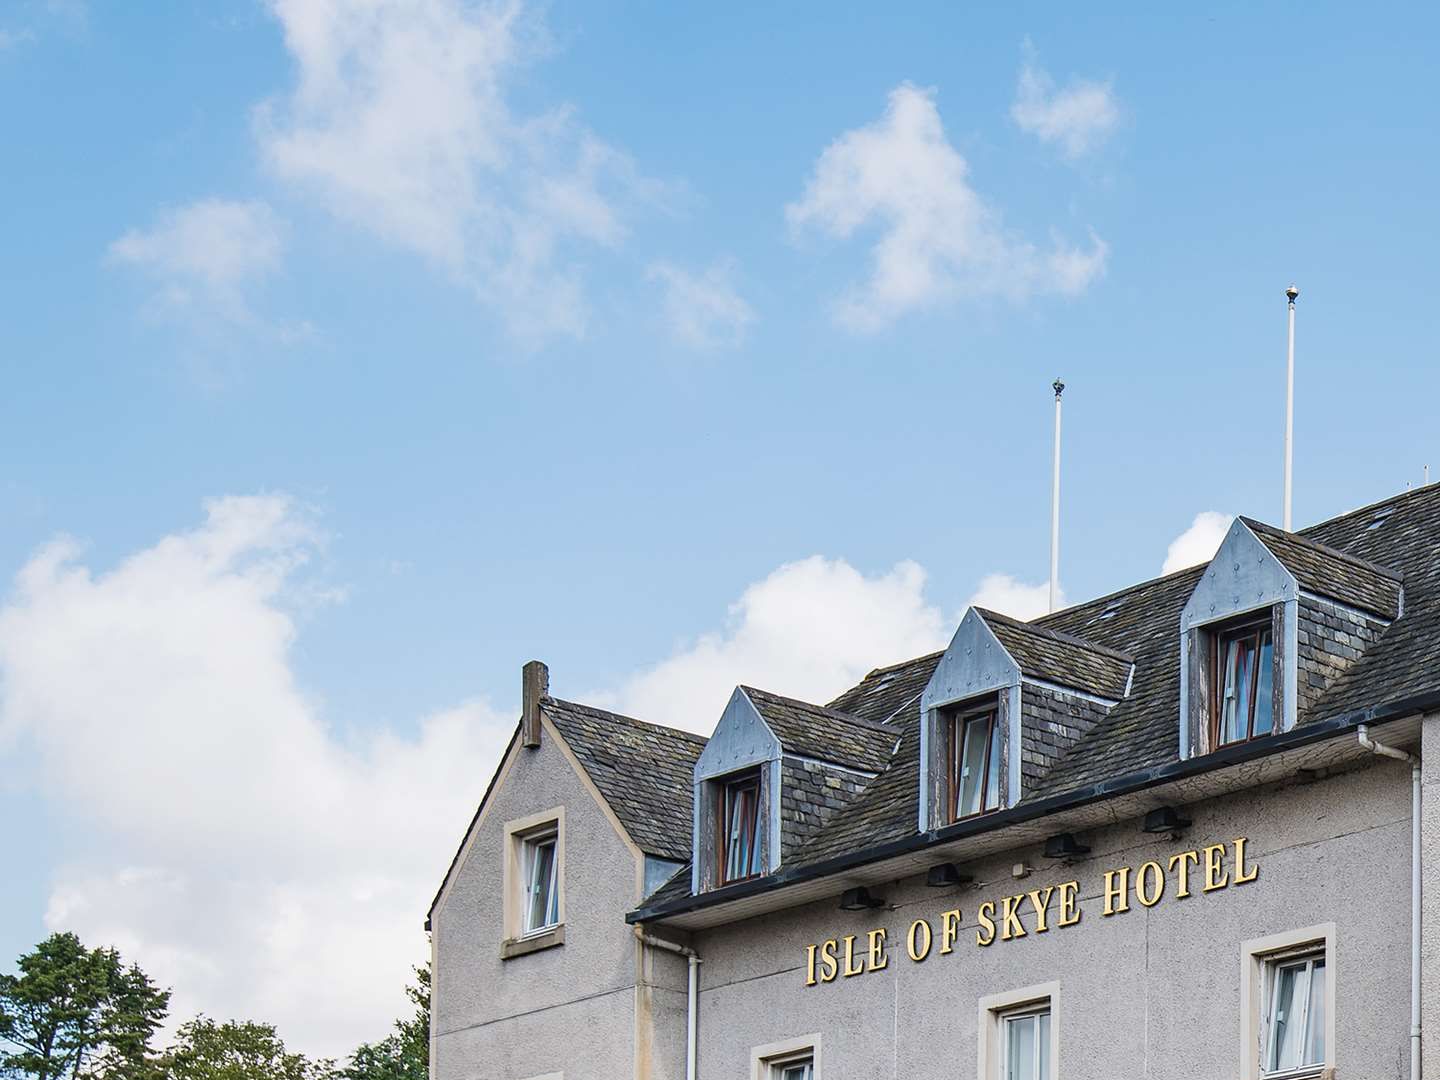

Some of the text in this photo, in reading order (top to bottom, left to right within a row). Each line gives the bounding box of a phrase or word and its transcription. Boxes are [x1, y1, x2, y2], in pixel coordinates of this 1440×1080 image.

[805, 837, 1258, 986] ISLE OF SKYE HOTEL
